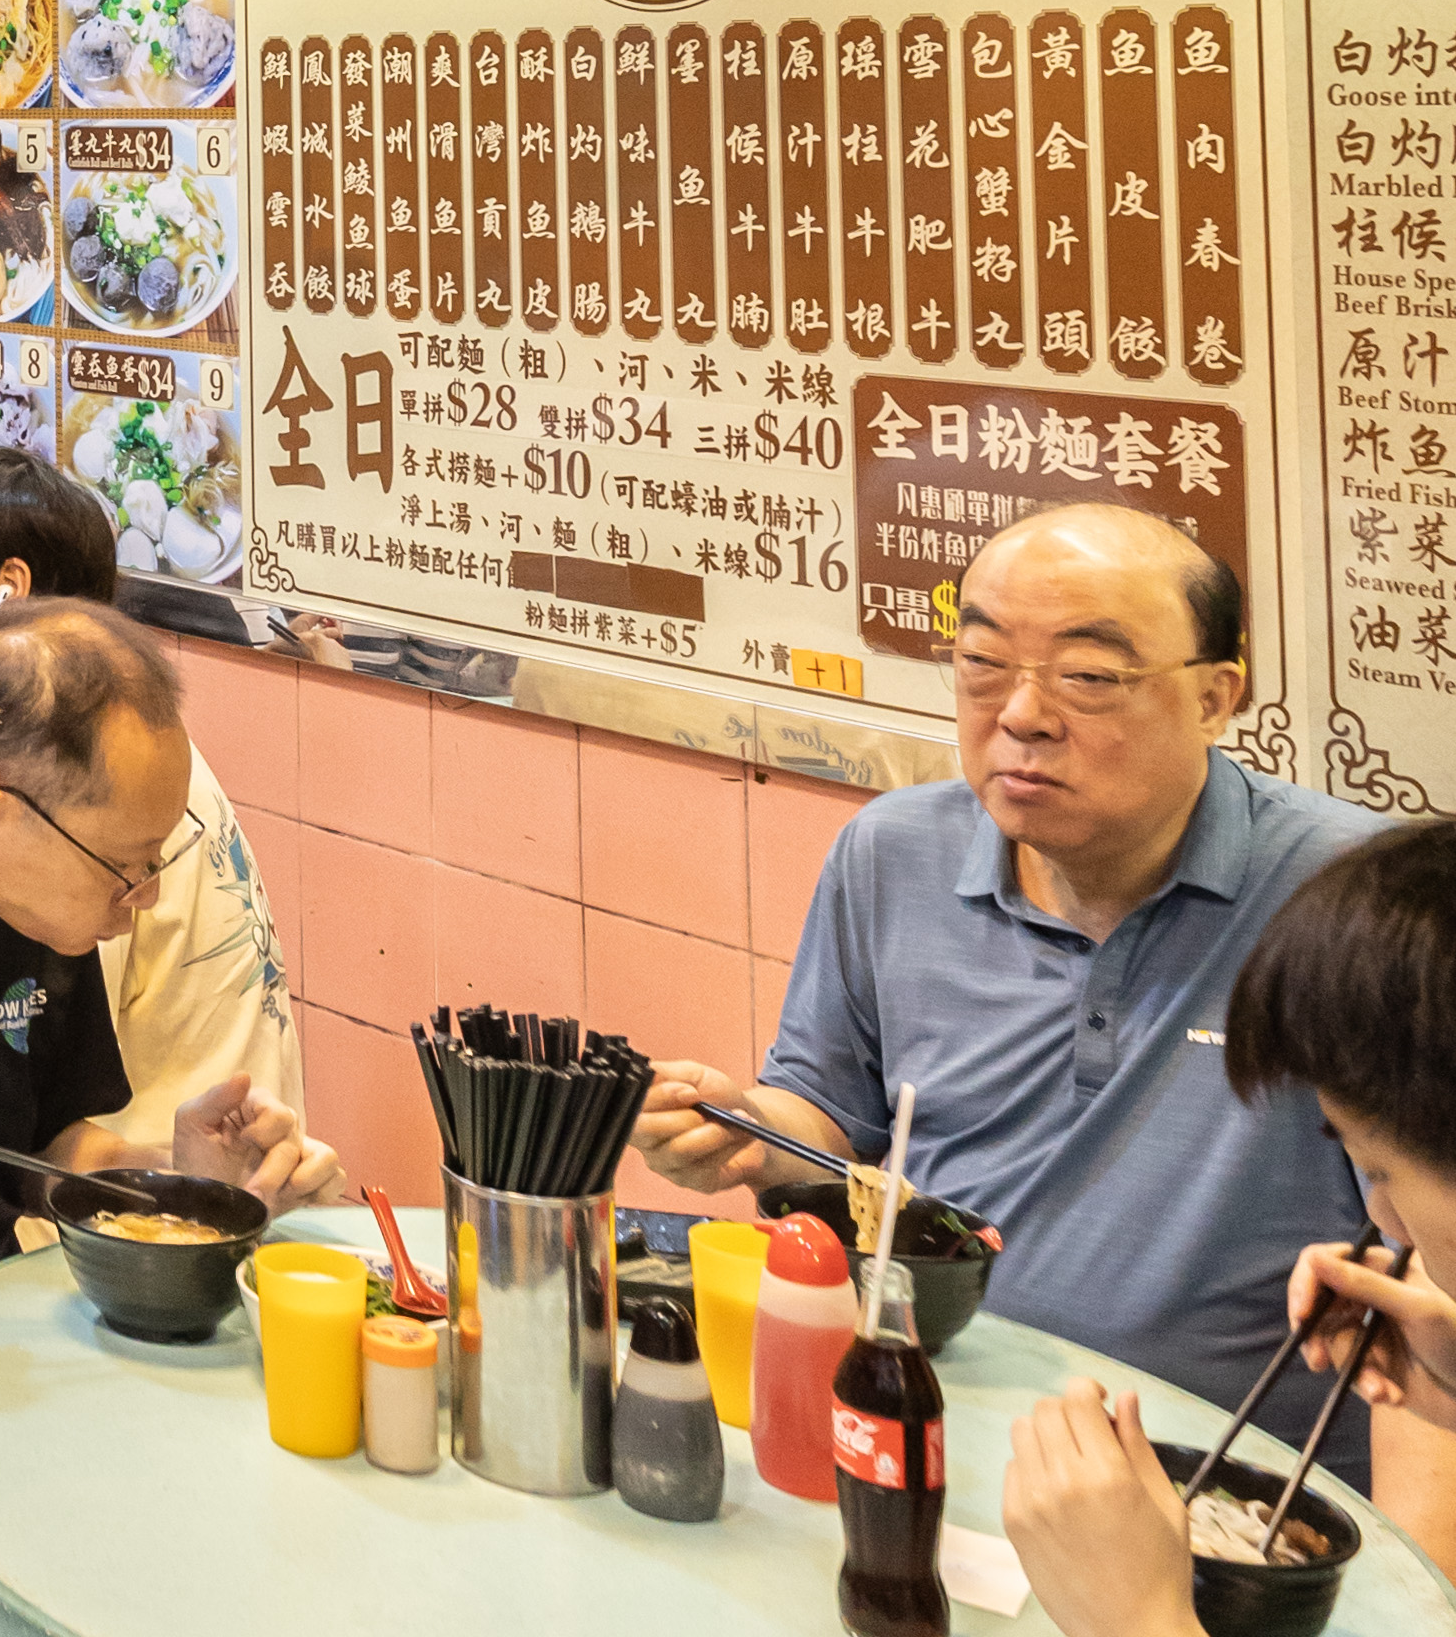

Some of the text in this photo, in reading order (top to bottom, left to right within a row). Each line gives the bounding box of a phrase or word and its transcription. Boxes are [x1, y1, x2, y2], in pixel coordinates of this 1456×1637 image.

[1327, 82, 1456, 106] Goose int
[26, 133, 38, 164] 5
[68, 128, 171, 171] 墨丸牛丸 $34
[206, 135, 221, 169] 6
[261, 50, 294, 299] 鮮蝦雲吞
[1336, 117, 1456, 171] 白灼
[301, 50, 335, 302] 鳳城水餃
[341, 50, 375, 305] 發菜鯪魚球
[382, 50, 420, 310] 潮州魚蛋
[429, 51, 462, 313] 爽滑魚片
[474, 46, 512, 312] 台灣貢丸
[520, 46, 558, 319] 酥炸魚皮
[569, 45, 607, 324] 白灼鵝腸
[616, 39, 662, 323] 鮮味牛丸
[670, 38, 716, 328] 墨魚丸
[724, 39, 770, 335] 柱候牛腩
[781, 36, 829, 337] 原汁牛肚
[903, 33, 953, 350] 雪花肥牛
[1031, 26, 1092, 360] 黃金片頭
[1103, 27, 1166, 366] 魚皮餃
[1177, 26, 1244, 371] 魚肉春卷
[1329, 172, 1444, 198] Marbled
[1331, 206, 1447, 263] 柱候
[1332, 264, 1407, 288] House
[1334, 291, 1388, 315] Beef
[27, 347, 40, 379] 8
[70, 350, 139, 383] 雲吞魚蛋
[137, 357, 174, 400] $34
[209, 367, 224, 402] 9
[1339, 327, 1450, 388] 原汁
[262, 327, 395, 494] 全日
[1337, 385, 1392, 410] Beef
[866, 390, 1232, 497] 全日粉麵套餐
[1343, 417, 1456, 478] 炸魚
[1341, 475, 1456, 508] Fried Fish
[1349, 506, 1456, 574] 紫菜
[1345, 566, 1446, 600] Seaweed
[741, 639, 791, 676] 外賣
[1349, 604, 1456, 667] 油菜
[1348, 657, 1423, 689] Steam
